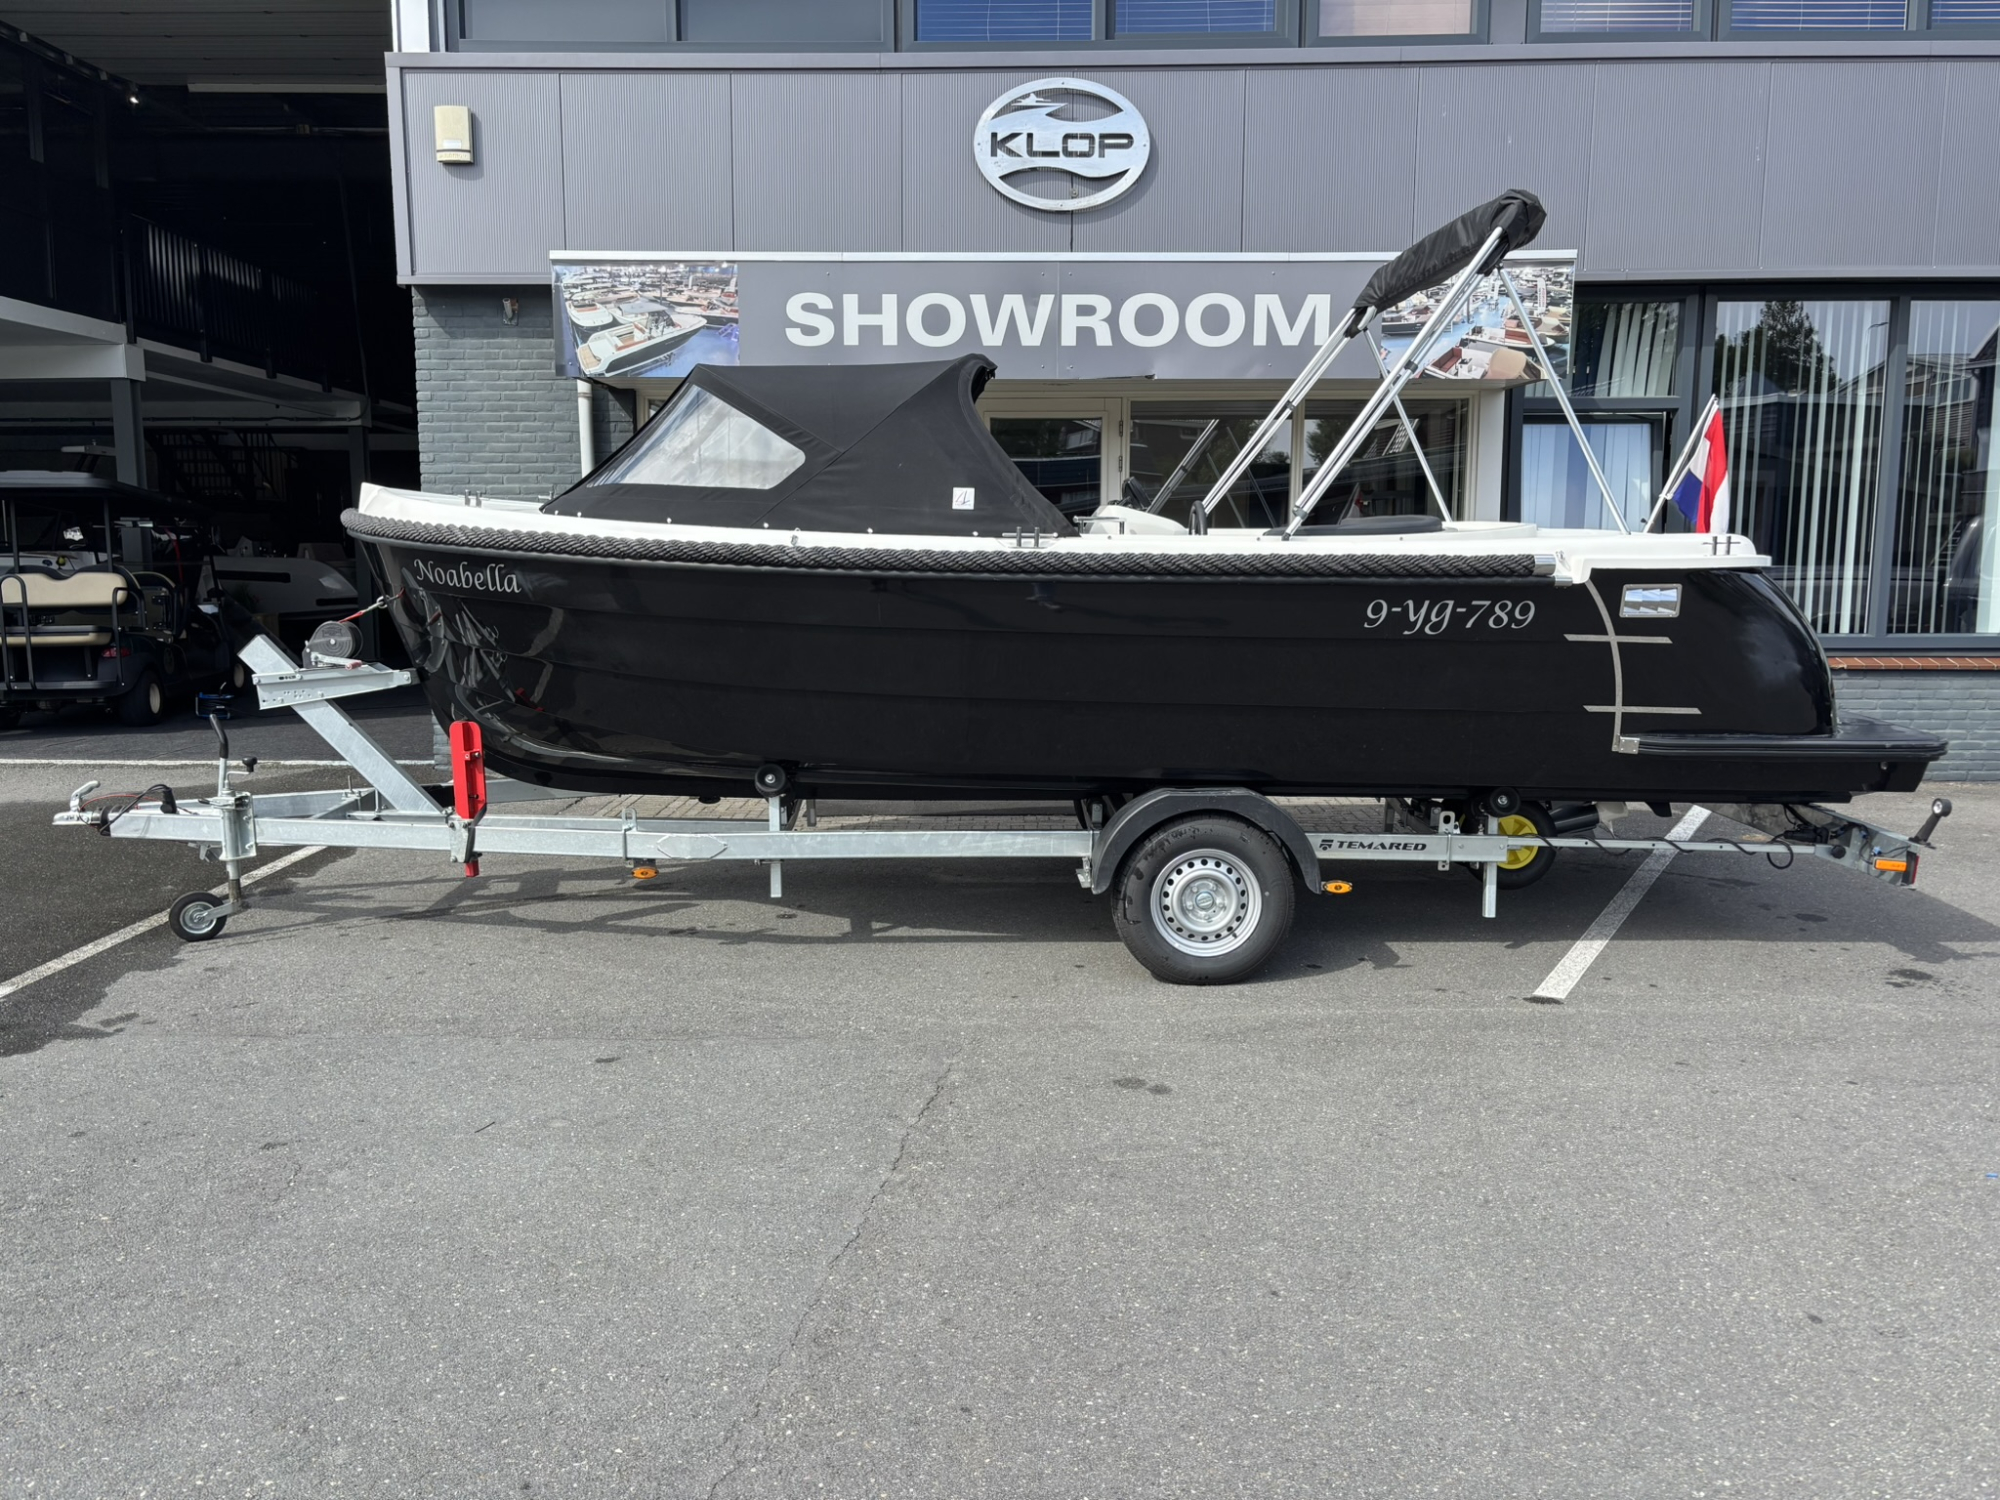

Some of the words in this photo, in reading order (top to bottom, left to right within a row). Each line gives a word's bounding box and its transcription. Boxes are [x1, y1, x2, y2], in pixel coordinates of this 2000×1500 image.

[990, 132, 1134, 158] KLOP
[784, 292, 1332, 347] SHOWROOM
[414, 558, 522, 593] Noabella
[1336, 840, 1427, 852] TEMARED
